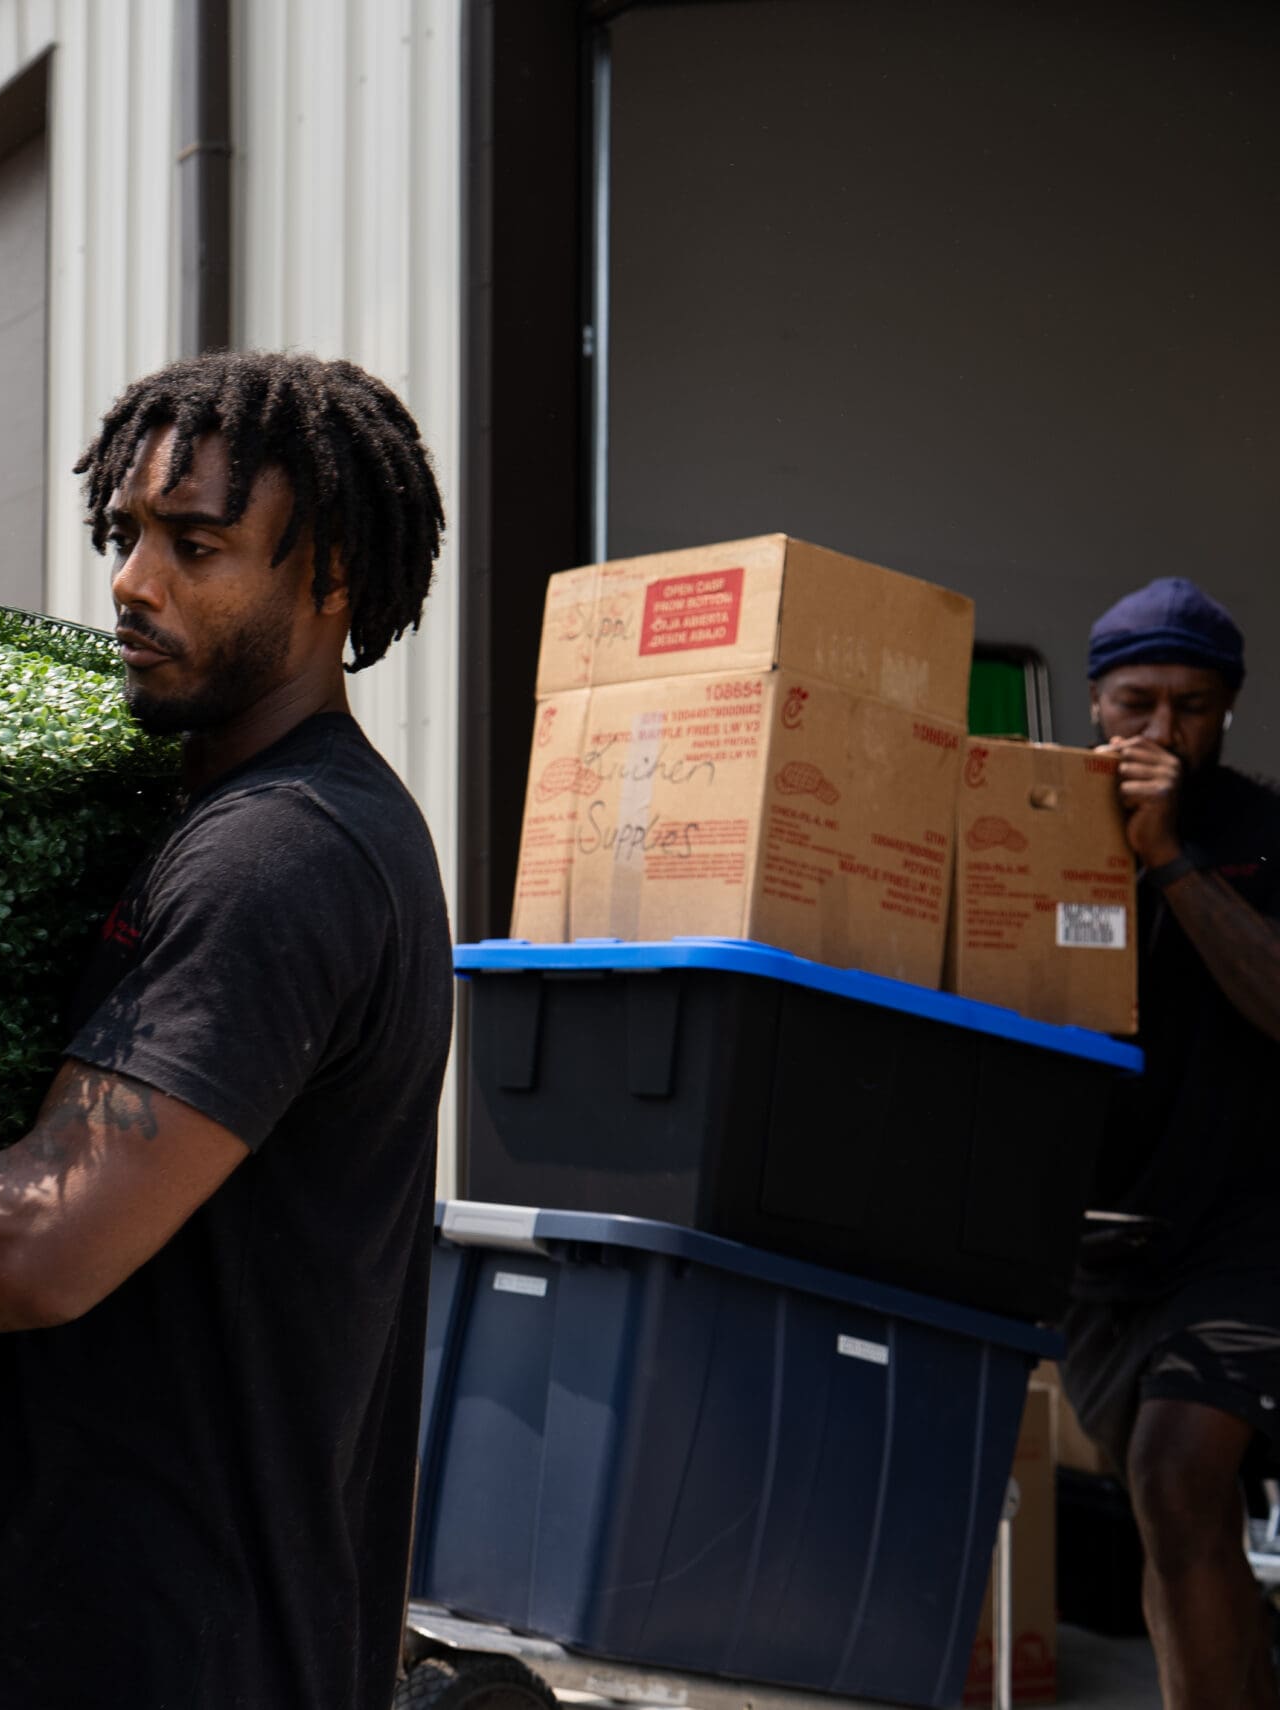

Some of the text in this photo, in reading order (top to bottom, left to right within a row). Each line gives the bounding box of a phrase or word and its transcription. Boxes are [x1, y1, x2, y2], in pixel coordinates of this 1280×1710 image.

[663, 579, 726, 599] OPEN CASE
[654, 592, 733, 613] FROM BOTTOM
[650, 610, 729, 632] CAJA ABIERTA
[648, 625, 727, 648] DESDE ABAJO
[706, 681, 762, 701] 108654
[686, 722, 721, 738] FRIES
[578, 800, 700, 860] Supplies
